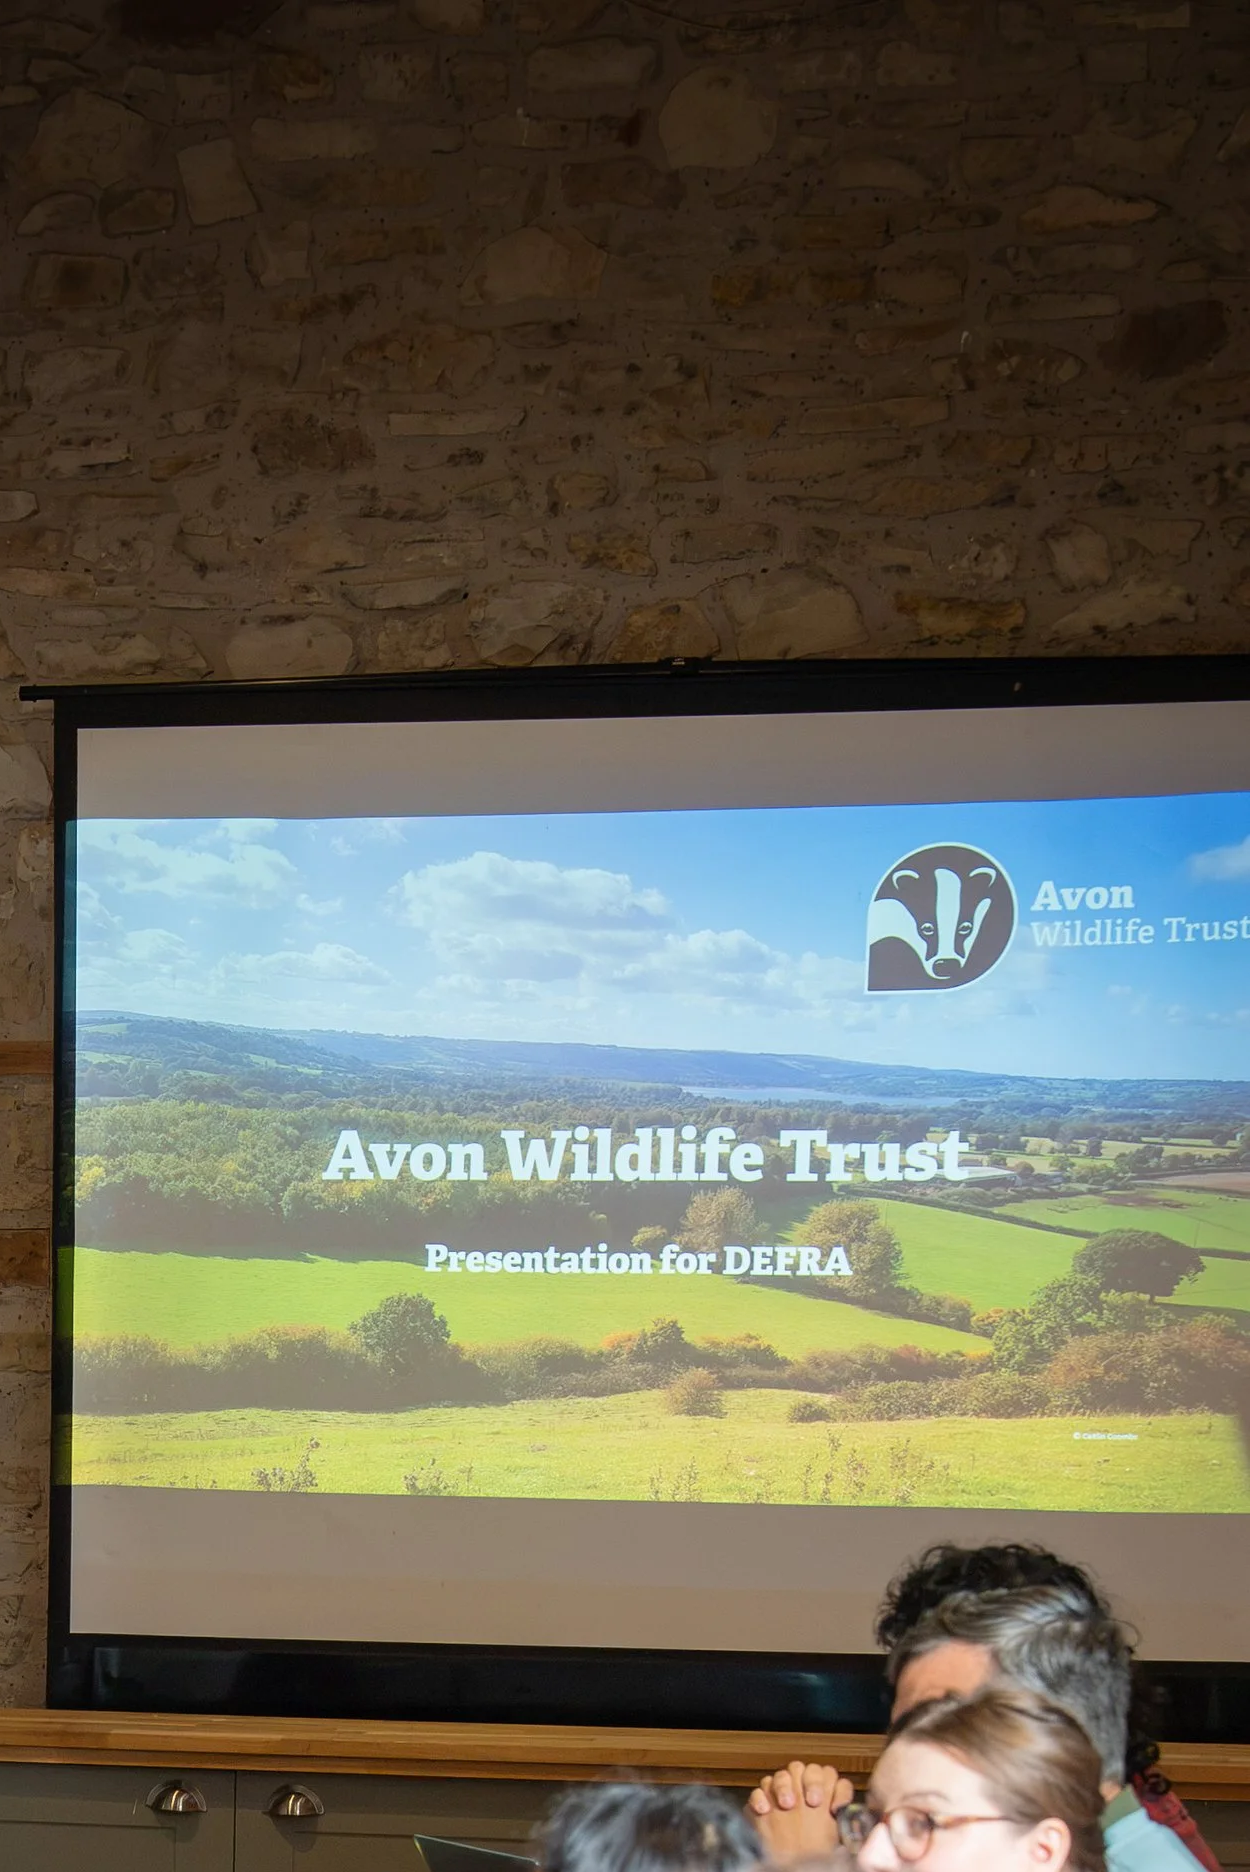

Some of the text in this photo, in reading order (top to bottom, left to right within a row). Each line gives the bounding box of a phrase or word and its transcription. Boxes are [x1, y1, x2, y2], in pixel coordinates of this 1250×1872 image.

[1030, 880, 1135, 912] Avon
[1030, 915, 1250, 947] Wildlife Trust
[322, 1125, 970, 1182] Avon Wildlife Trust
[424, 1243, 853, 1276] Presentation for DEFRA
